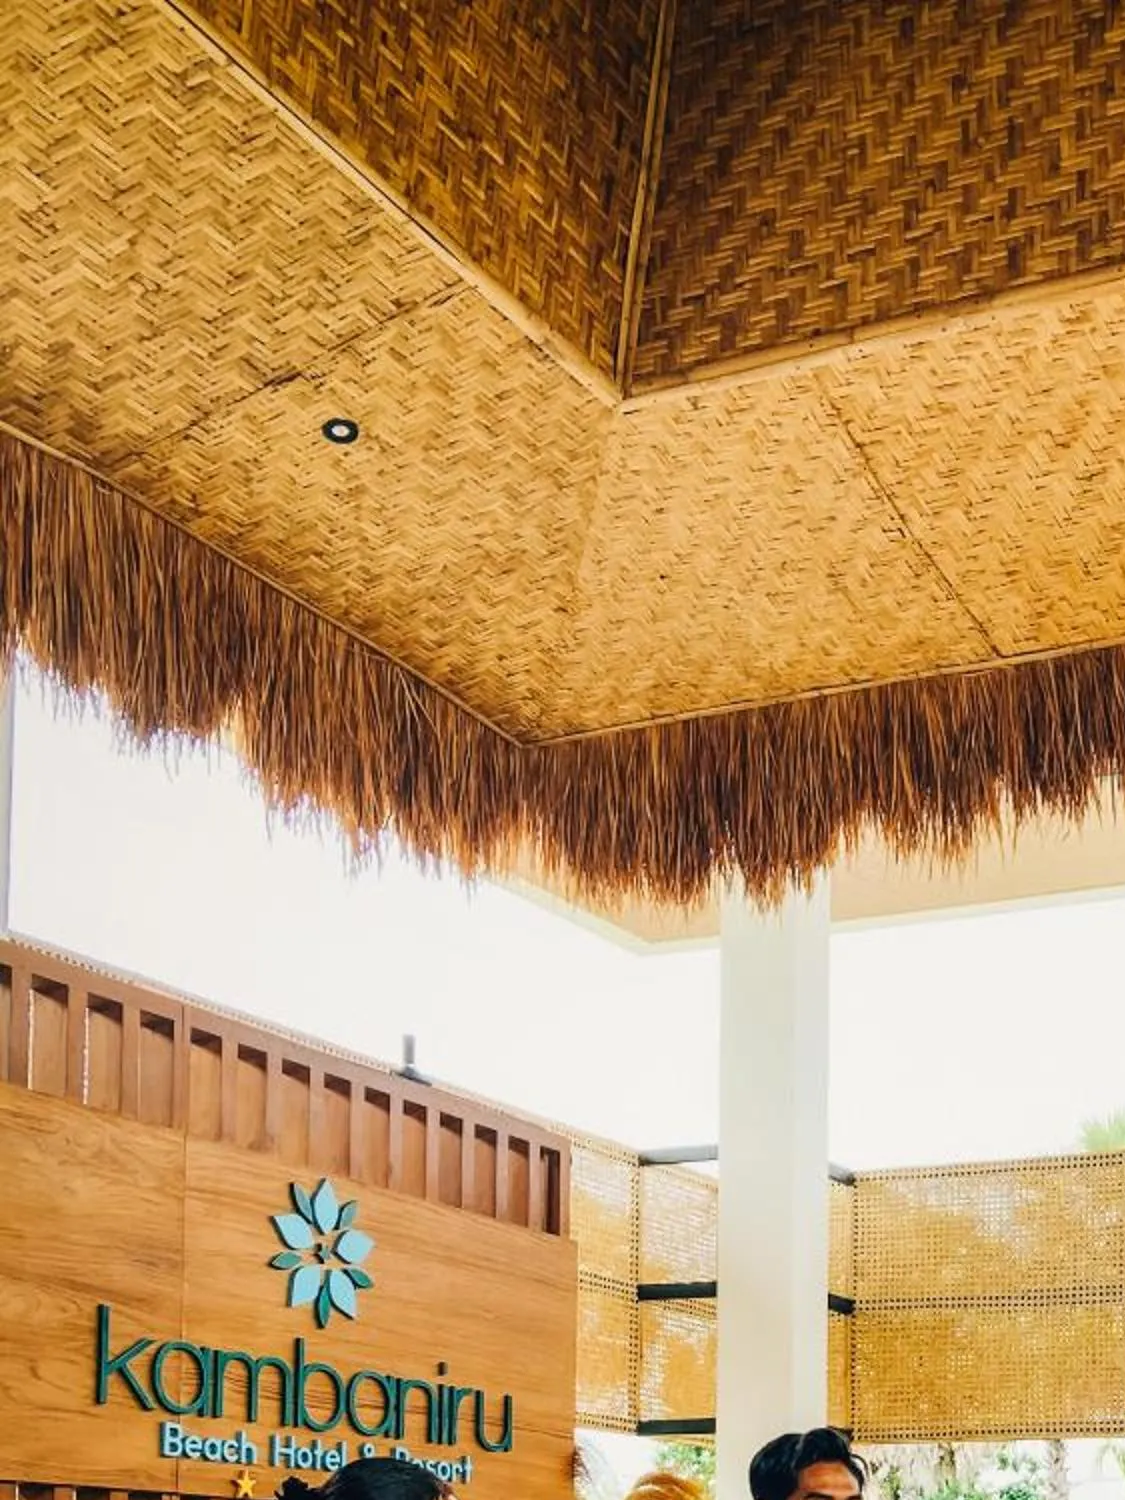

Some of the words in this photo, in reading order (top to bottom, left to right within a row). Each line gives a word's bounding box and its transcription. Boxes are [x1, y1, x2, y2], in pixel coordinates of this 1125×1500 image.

[96, 1304, 513, 1452] kambaniru
[160, 1421, 257, 1464] Beach
[271, 1434, 347, 1472] Hotel
